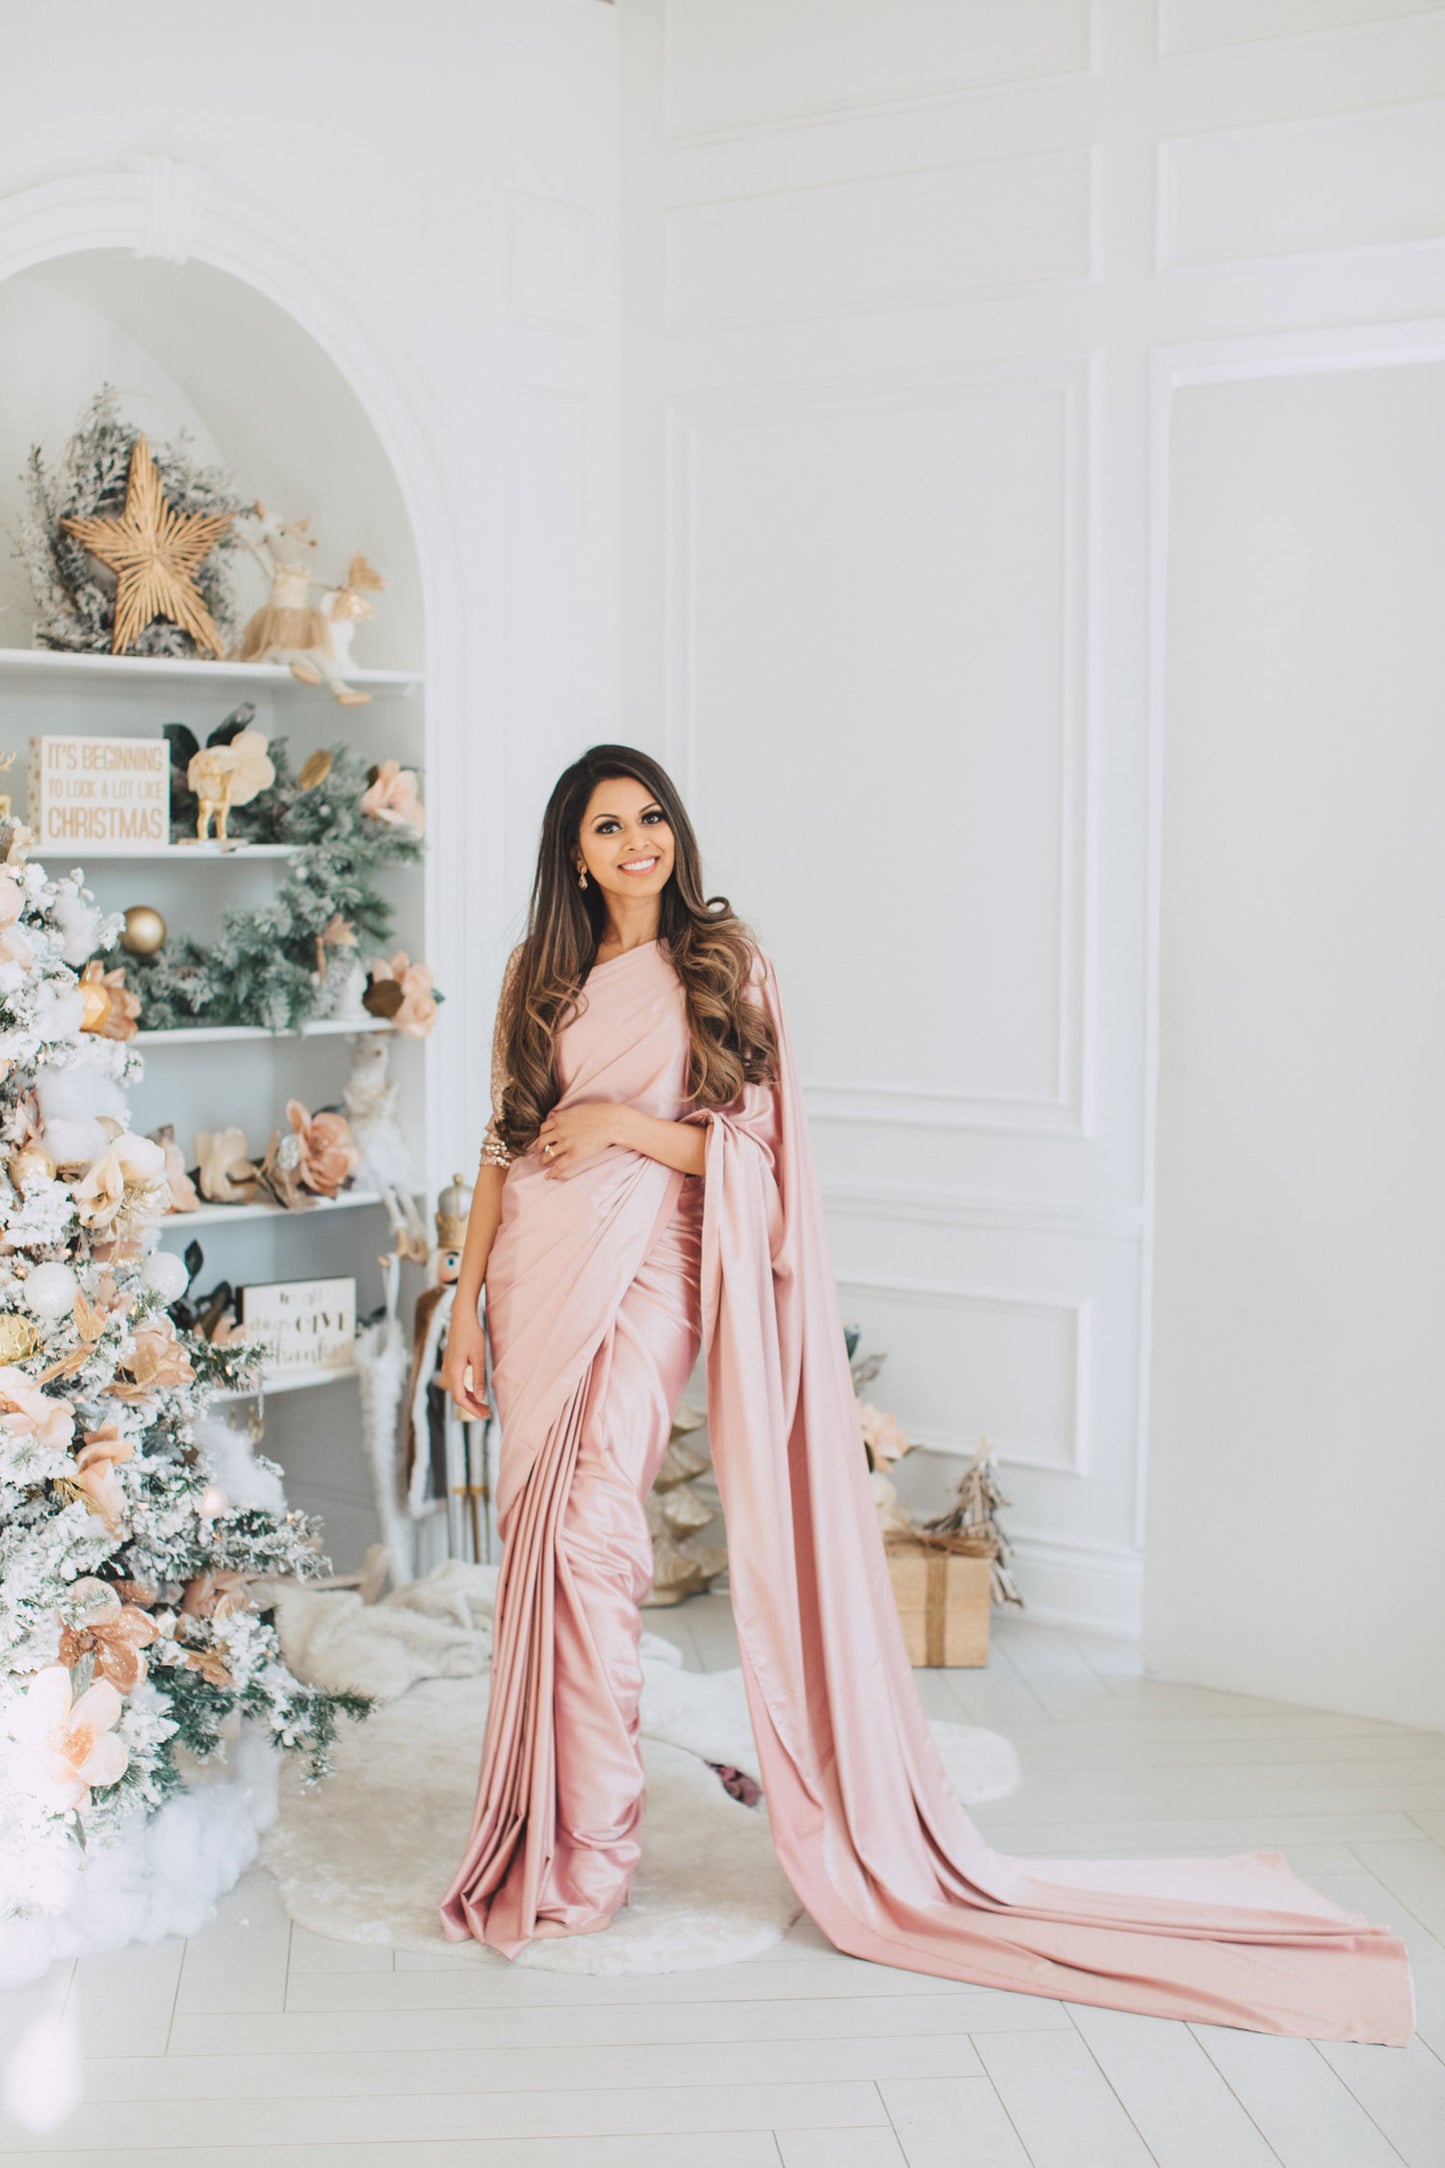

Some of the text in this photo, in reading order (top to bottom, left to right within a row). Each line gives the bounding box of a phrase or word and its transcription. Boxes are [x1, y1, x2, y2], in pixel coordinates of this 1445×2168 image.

[48, 743, 163, 771] IT'S BEGINNING
[49, 779, 163, 798] TO LOOK A LOT LIKE
[48, 806, 162, 839] CHRISTMAS
